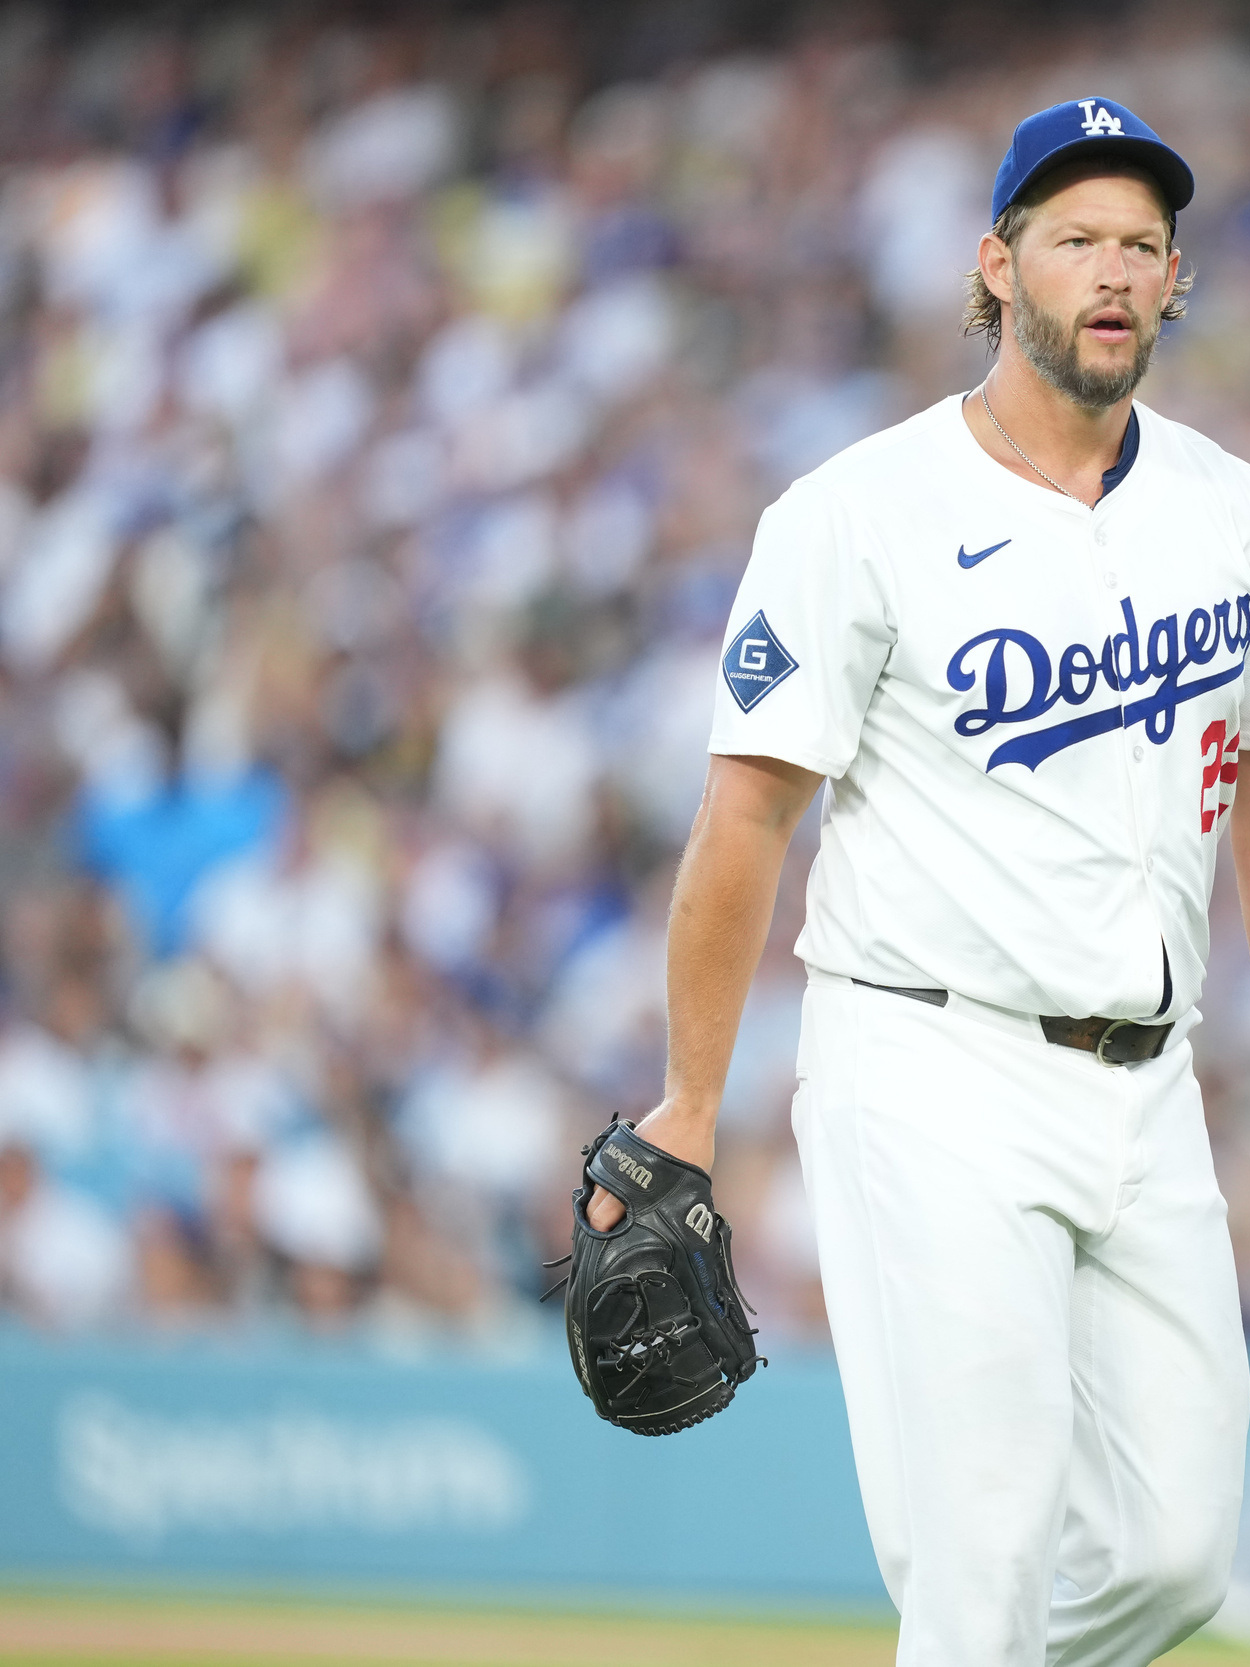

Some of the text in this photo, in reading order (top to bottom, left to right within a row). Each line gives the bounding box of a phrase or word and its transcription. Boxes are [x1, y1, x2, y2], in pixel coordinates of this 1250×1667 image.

[1078, 100, 1125, 136] LA
[739, 638, 768, 671] G
[605, 1143, 653, 1190] Wilson
